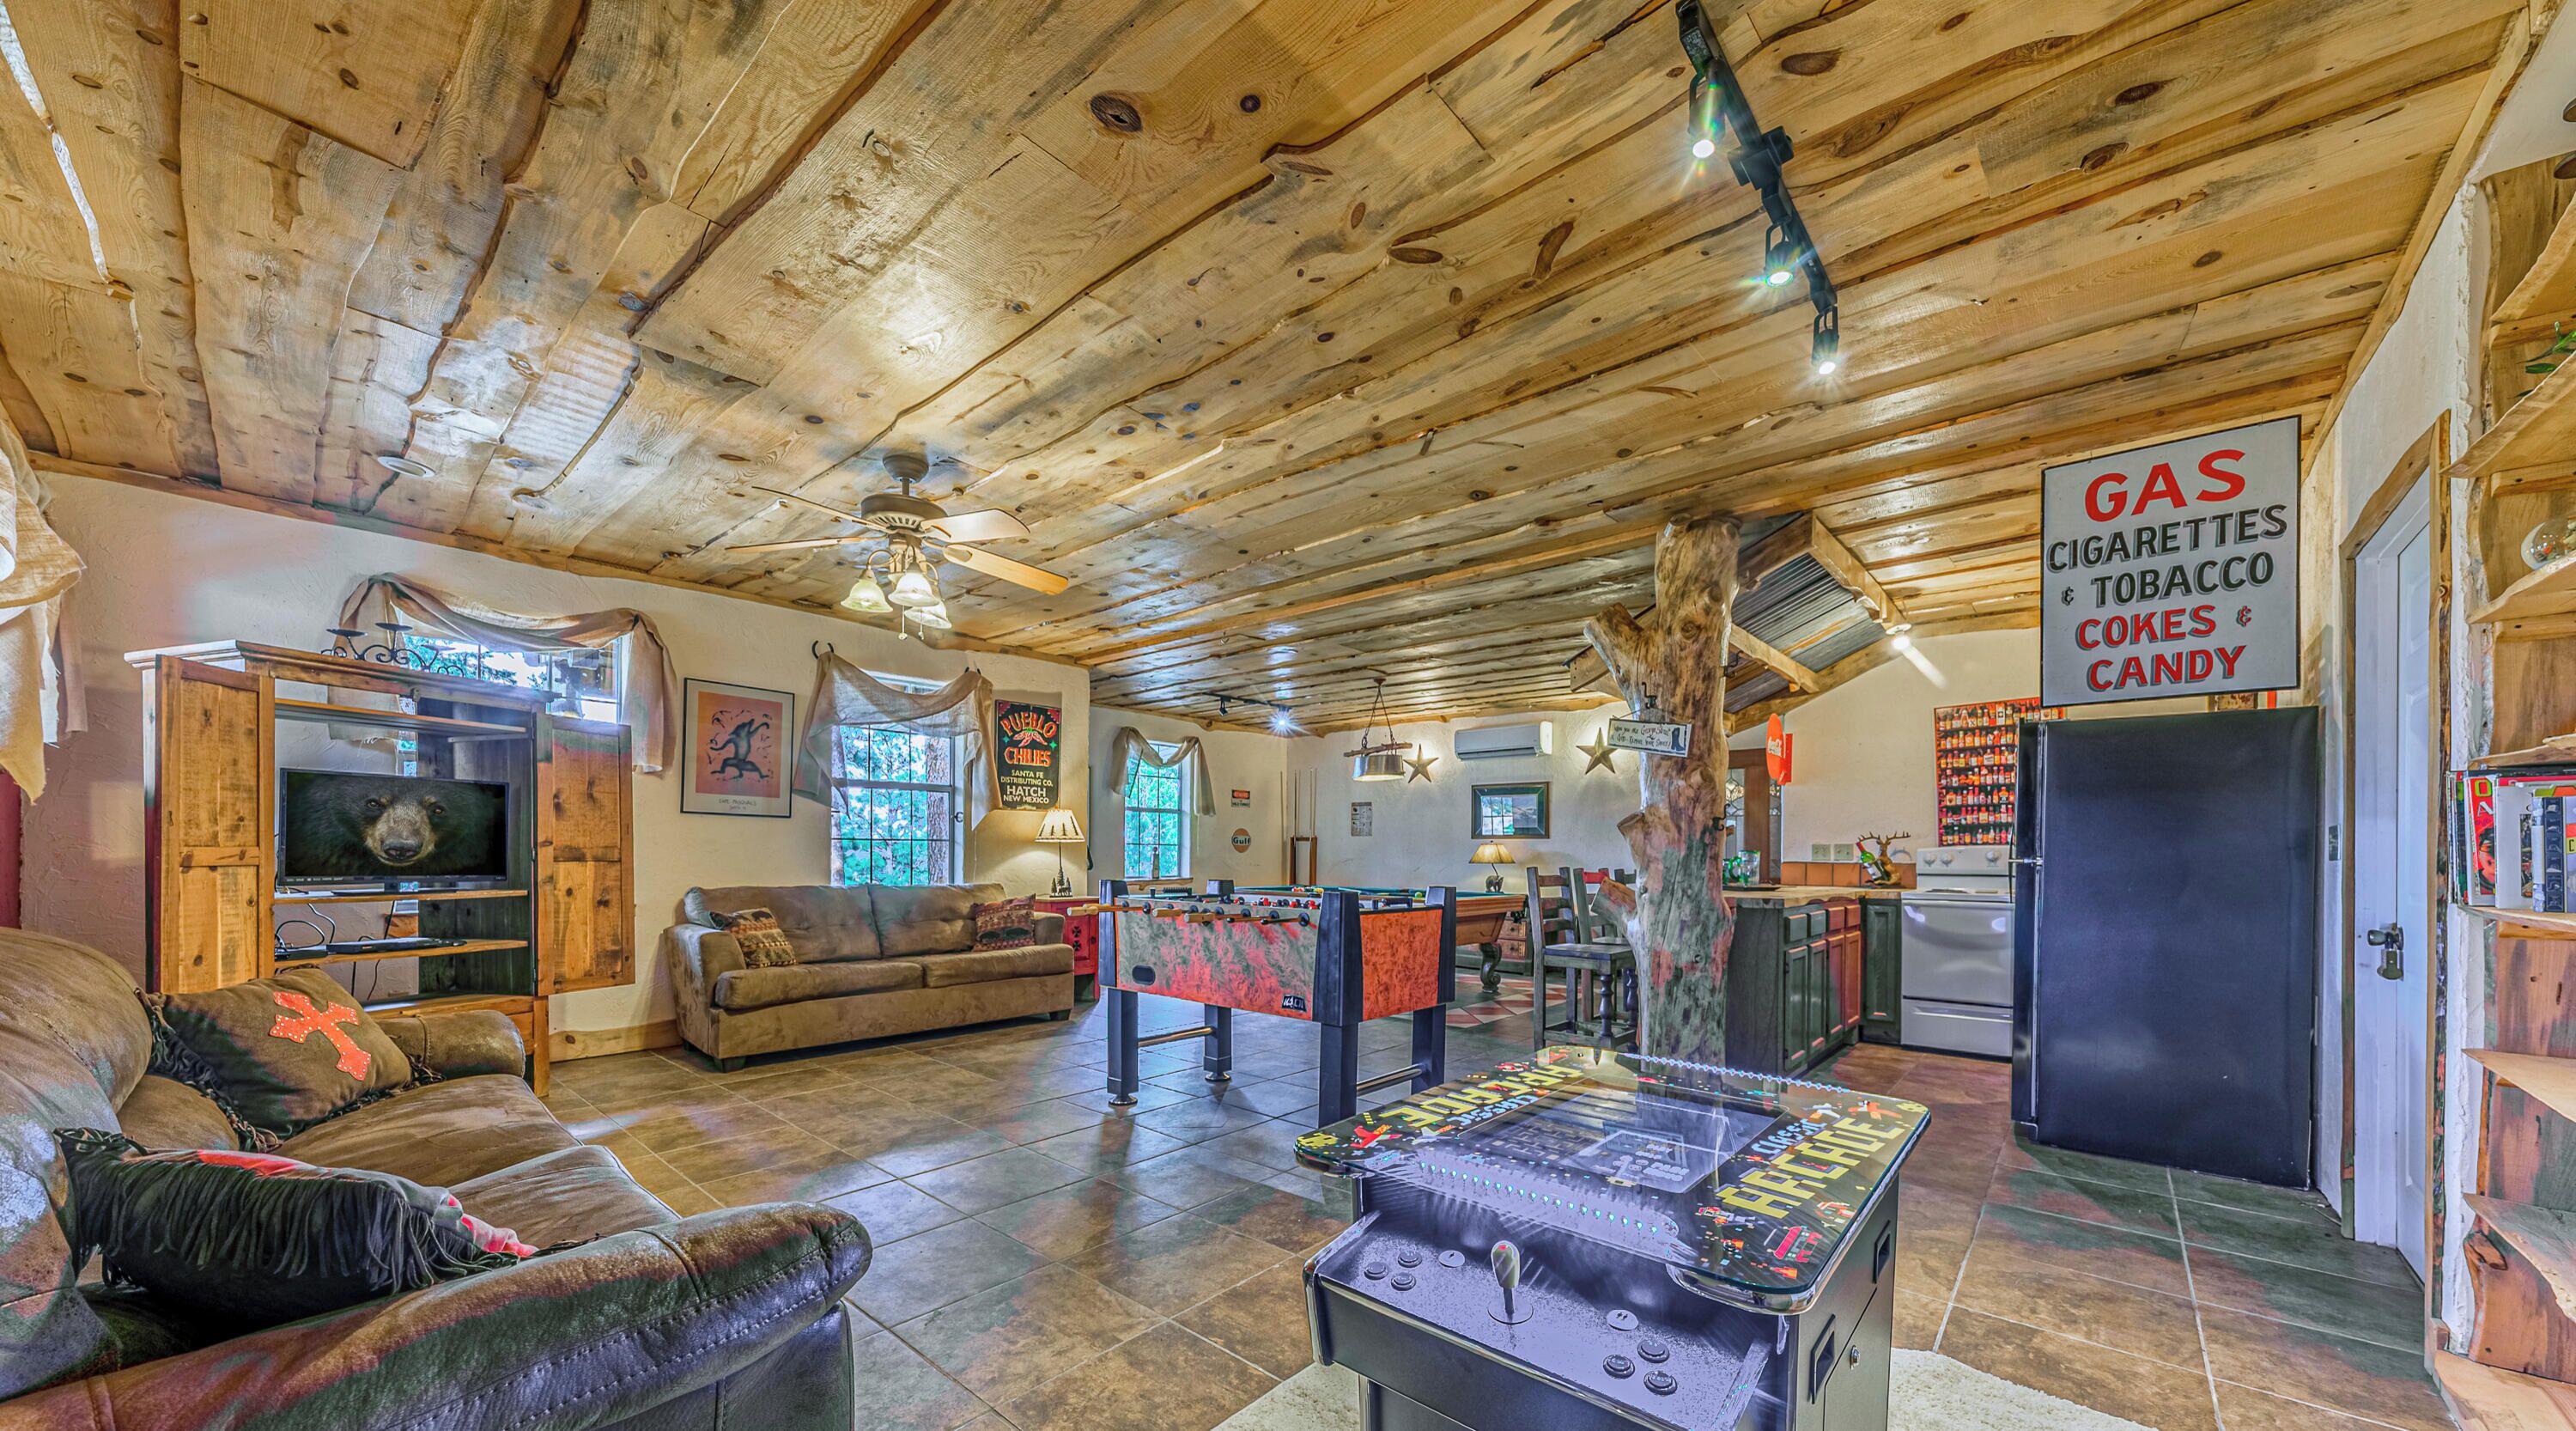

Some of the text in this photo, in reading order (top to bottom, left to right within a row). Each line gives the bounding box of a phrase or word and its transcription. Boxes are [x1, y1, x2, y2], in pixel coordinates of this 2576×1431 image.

[2084, 449, 2246, 522] GAS
[2046, 504, 2287, 573] CIGARETTES
[2091, 551, 2275, 608] TOBACCO
[2075, 605, 2217, 650] COKES
[2087, 645, 2247, 692] CANDY
[1000, 711, 1058, 738] PUEBLO
[1004, 746, 1052, 767] CHILIES
[1012, 770, 1034, 778] SANTA
[1000, 776, 1042, 786] DISTRIBUTING
[1006, 785, 1047, 797] HATCH
[1233, 837, 1251, 845] Gulf
[1379, 1064, 1584, 1128] ARCADE
[1751, 1118, 1827, 1154] CLASSIC
[1716, 1117, 1905, 1219] ARCADE
